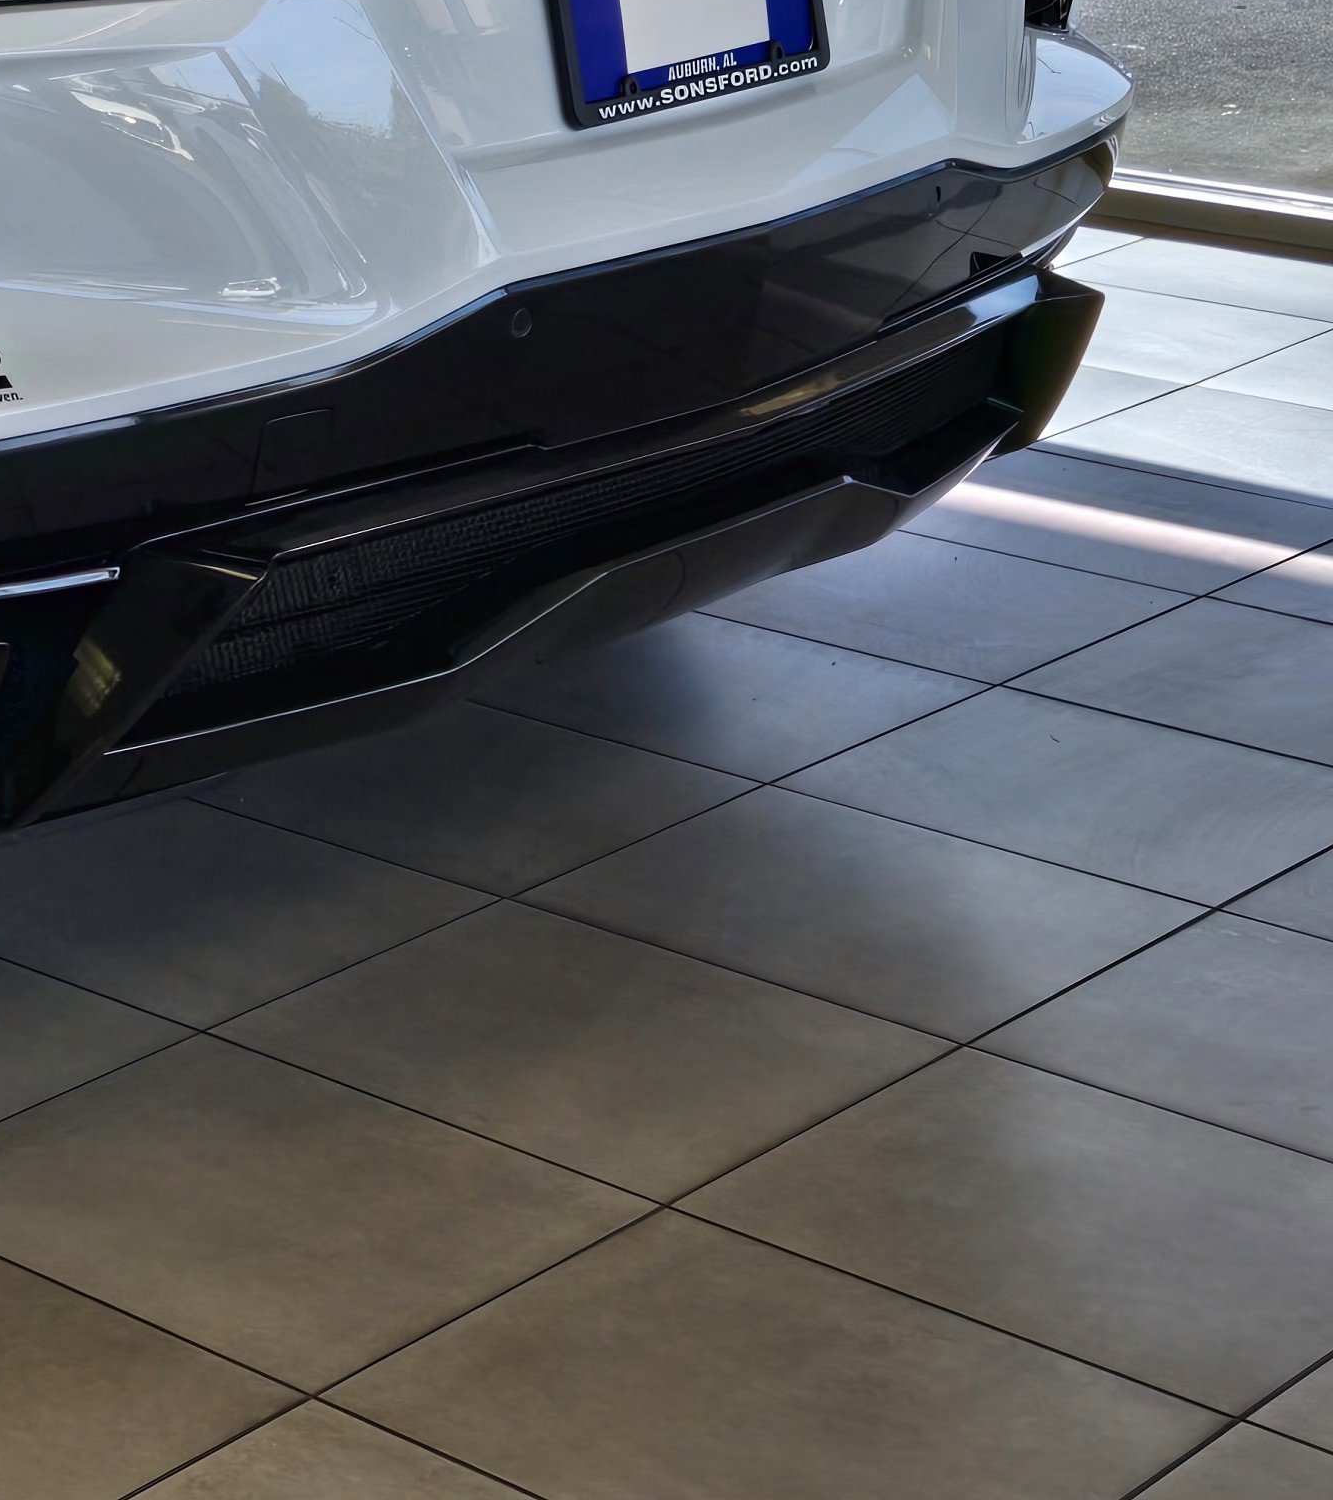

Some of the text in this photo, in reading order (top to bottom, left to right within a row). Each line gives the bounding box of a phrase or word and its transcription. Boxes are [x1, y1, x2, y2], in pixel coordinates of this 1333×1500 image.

[598, 56, 818, 119] www.SONSFORD.com
[668, 51, 738, 81] AUBURN, AL
